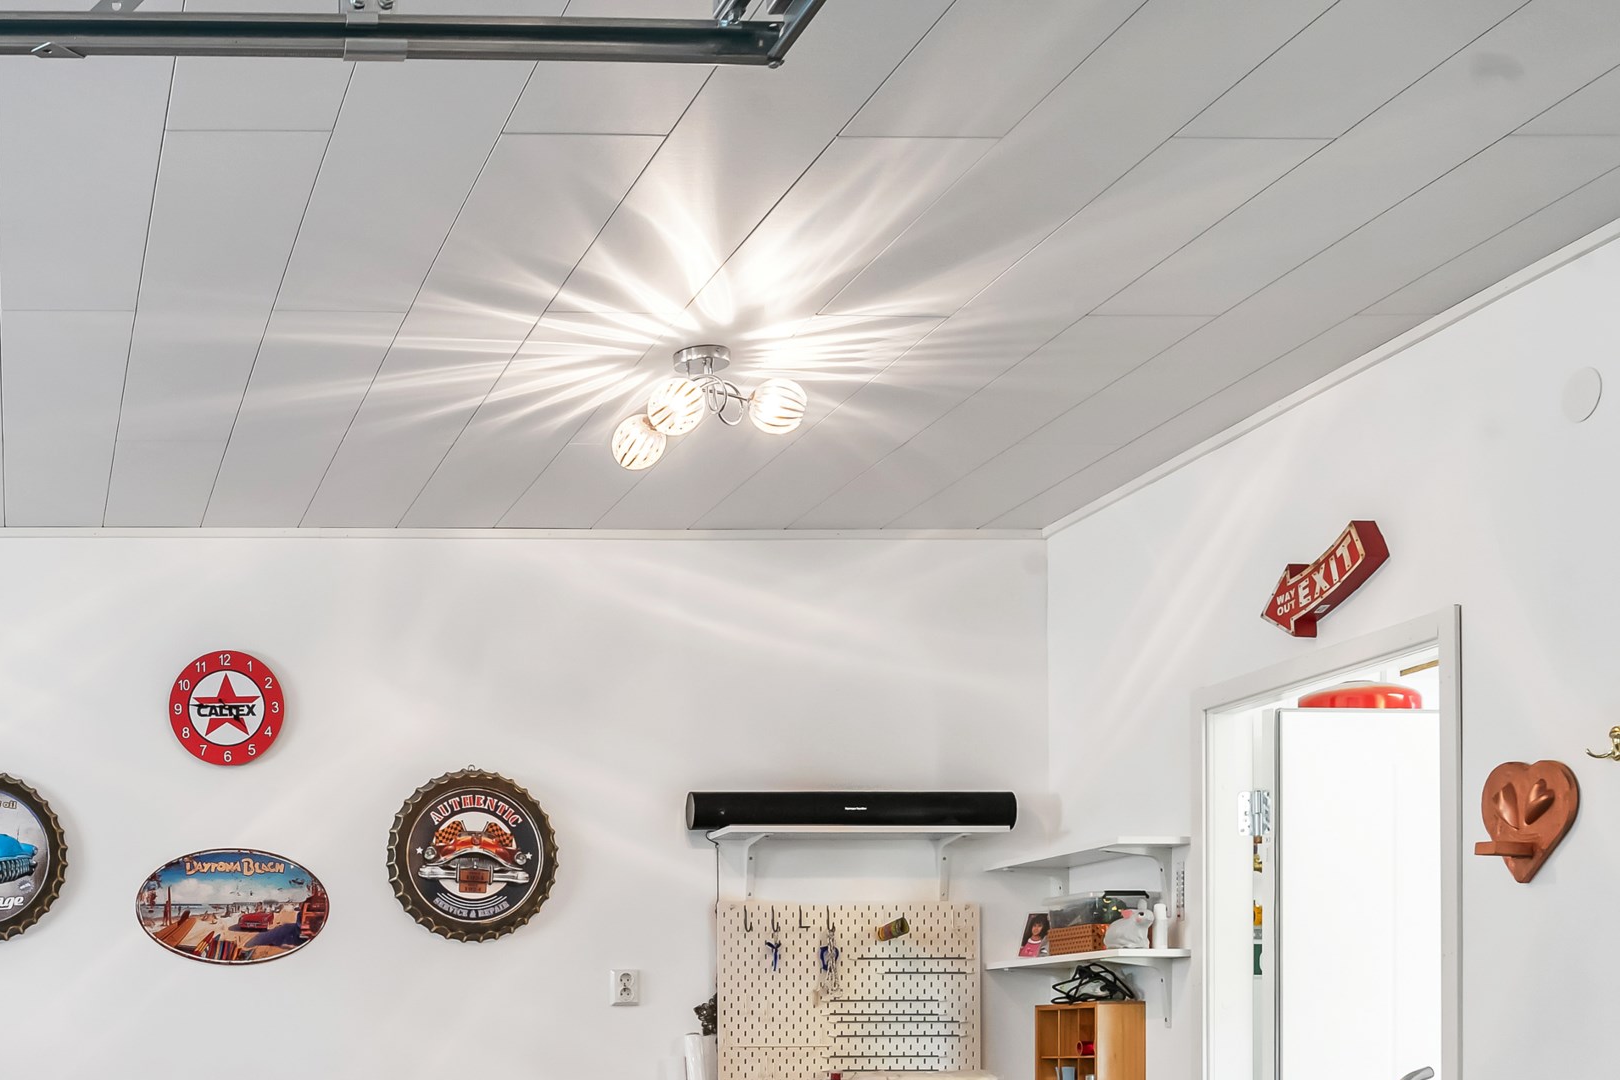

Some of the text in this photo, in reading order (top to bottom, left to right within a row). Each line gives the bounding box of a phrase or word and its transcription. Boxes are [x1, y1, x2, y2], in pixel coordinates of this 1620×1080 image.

[1298, 533, 1352, 608] EXIT
[1276, 588, 1295, 605] WAY
[1276, 599, 1295, 616] OUT
[218, 653, 231, 666] 12
[246, 660, 253, 672] 1
[195, 661, 207, 673] 11
[177, 679, 191, 691] 10
[264, 676, 273, 689] 2
[173, 703, 183, 715] 9
[196, 703, 257, 717] CALTEX
[271, 701, 280, 713] 3
[181, 726, 191, 739] 8
[264, 725, 273, 738] 4
[199, 744, 208, 756] 7
[247, 743, 257, 756] 5
[223, 750, 233, 763] 6
[429, 795, 523, 828] AUTHENTIC
[432, 897, 469, 917] SERVICE
[477, 900, 510, 918] REPAIR
